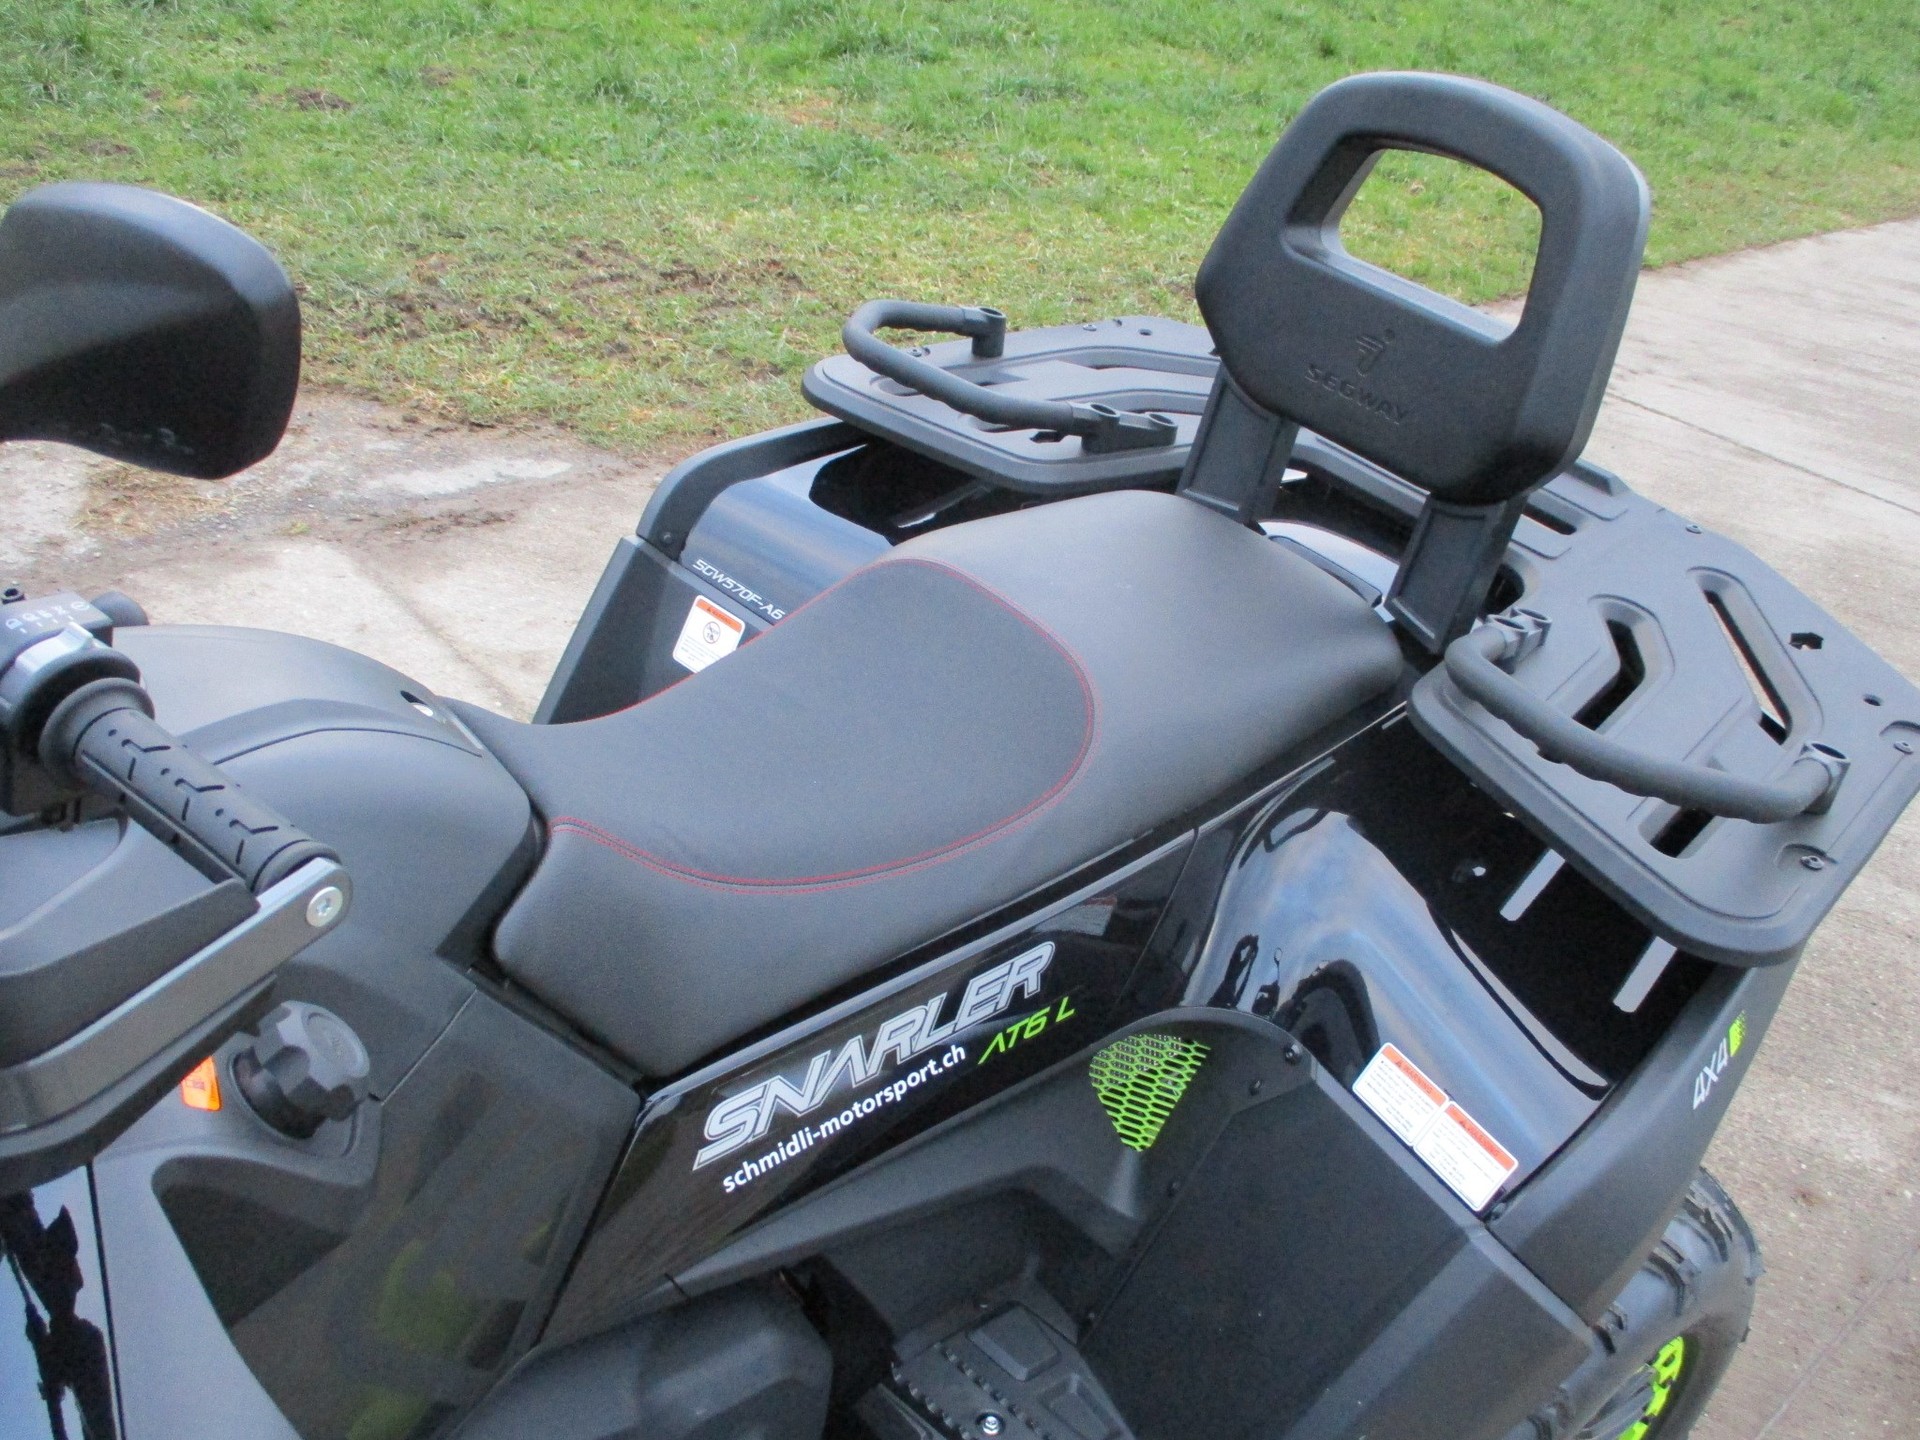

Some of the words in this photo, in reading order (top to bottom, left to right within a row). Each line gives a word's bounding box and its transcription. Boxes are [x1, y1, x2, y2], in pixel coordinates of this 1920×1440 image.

[1304, 363, 1408, 426] SEGWAY
[692, 558, 786, 620] SGW570F-A6
[692, 941, 1056, 1171] SNARLER
[723, 1044, 966, 1193] schmidli-motorsport.ch
